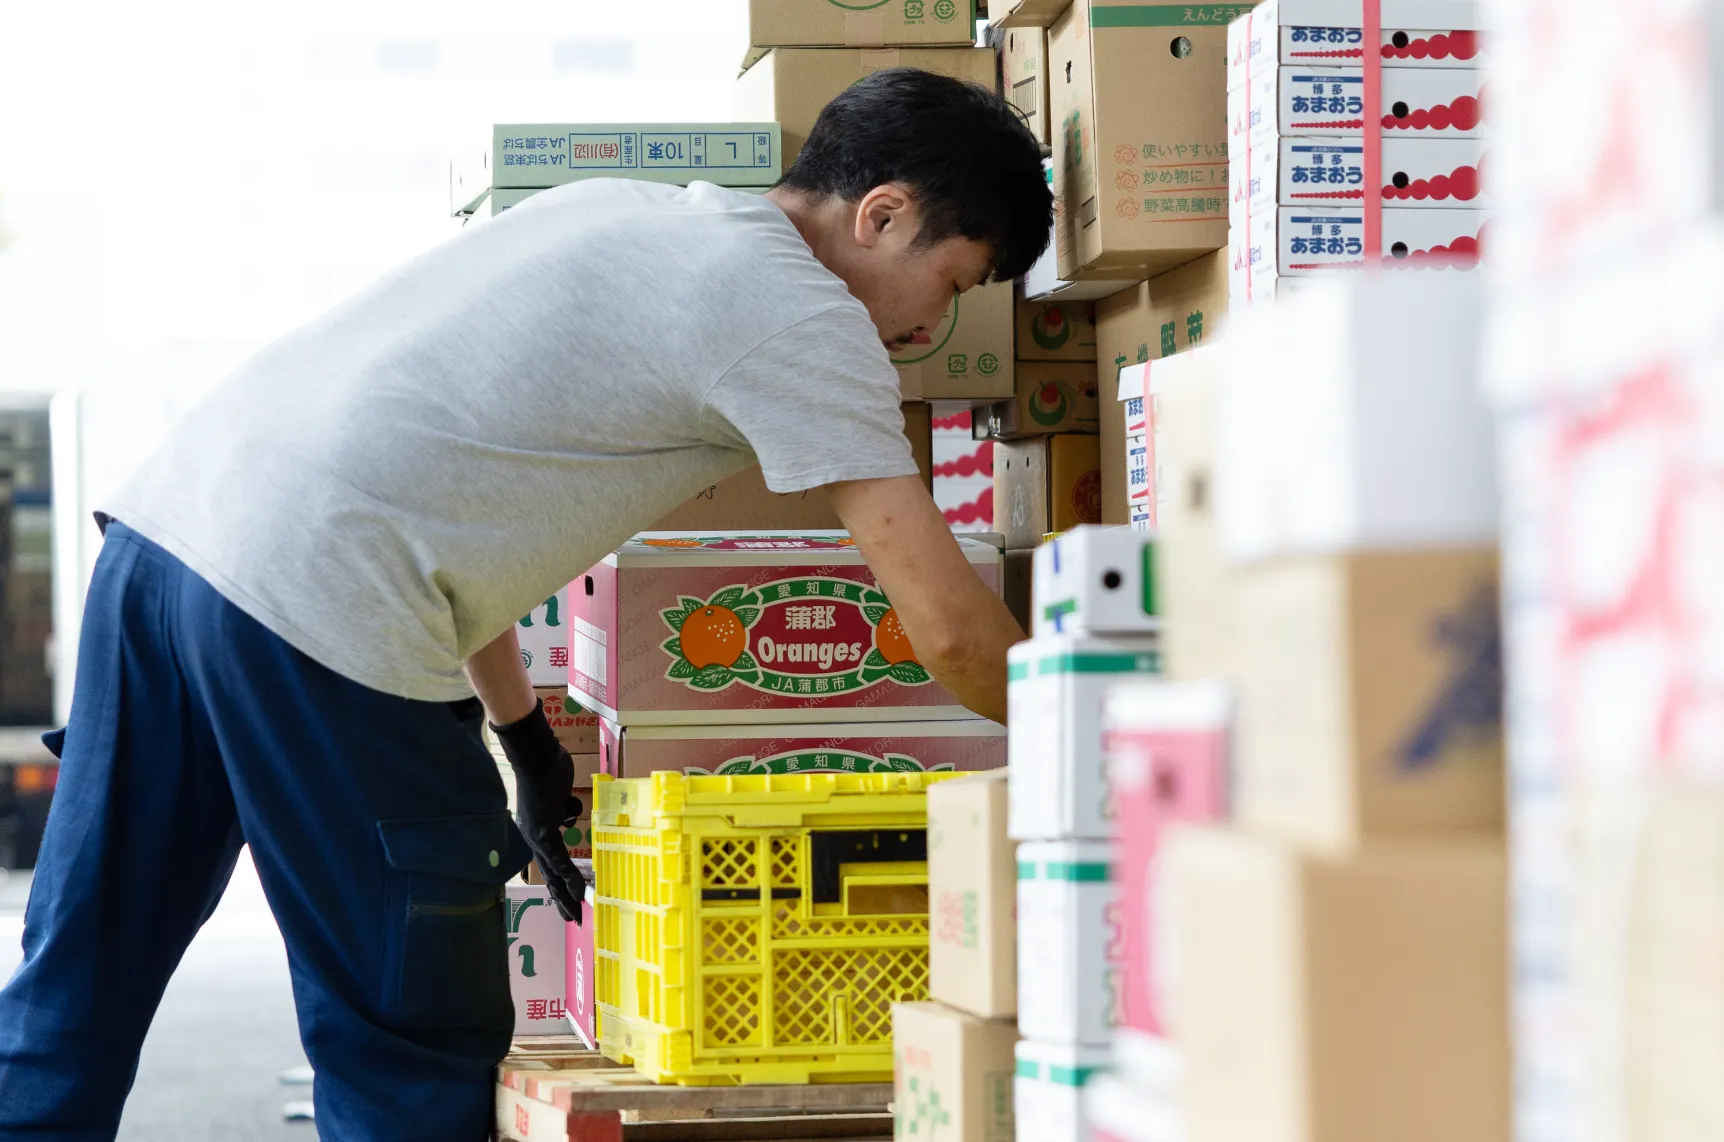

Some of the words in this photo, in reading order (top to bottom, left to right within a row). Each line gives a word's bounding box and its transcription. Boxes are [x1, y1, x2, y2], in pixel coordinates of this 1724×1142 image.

[1183, 7, 1251, 22] えんどう
[1313, 84, 1342, 95] 博多
[1292, 96, 1363, 114] あまおう
[503, 137, 565, 150] JA全農ちば
[574, 143, 619, 159] (有)川辺
[625, 136, 633, 165] 生産者
[648, 142, 684, 160] 10束
[725, 142, 736, 158] L
[757, 135, 767, 164] 等級
[504, 153, 566, 165] JAちば東葛
[1313, 154, 1342, 165] 博多
[1292, 166, 1362, 184] あまおう
[1144, 197, 1228, 213] 野菜高騰時
[1312, 225, 1342, 236] 博多
[1291, 237, 1362, 255] あまおう
[778, 581, 847, 598] 愛知県
[785, 606, 837, 630] 蒲郡
[758, 636, 862, 670] Oranges
[771, 675, 846, 693] JA蒲郡市
[786, 754, 856, 771] 愛知県
